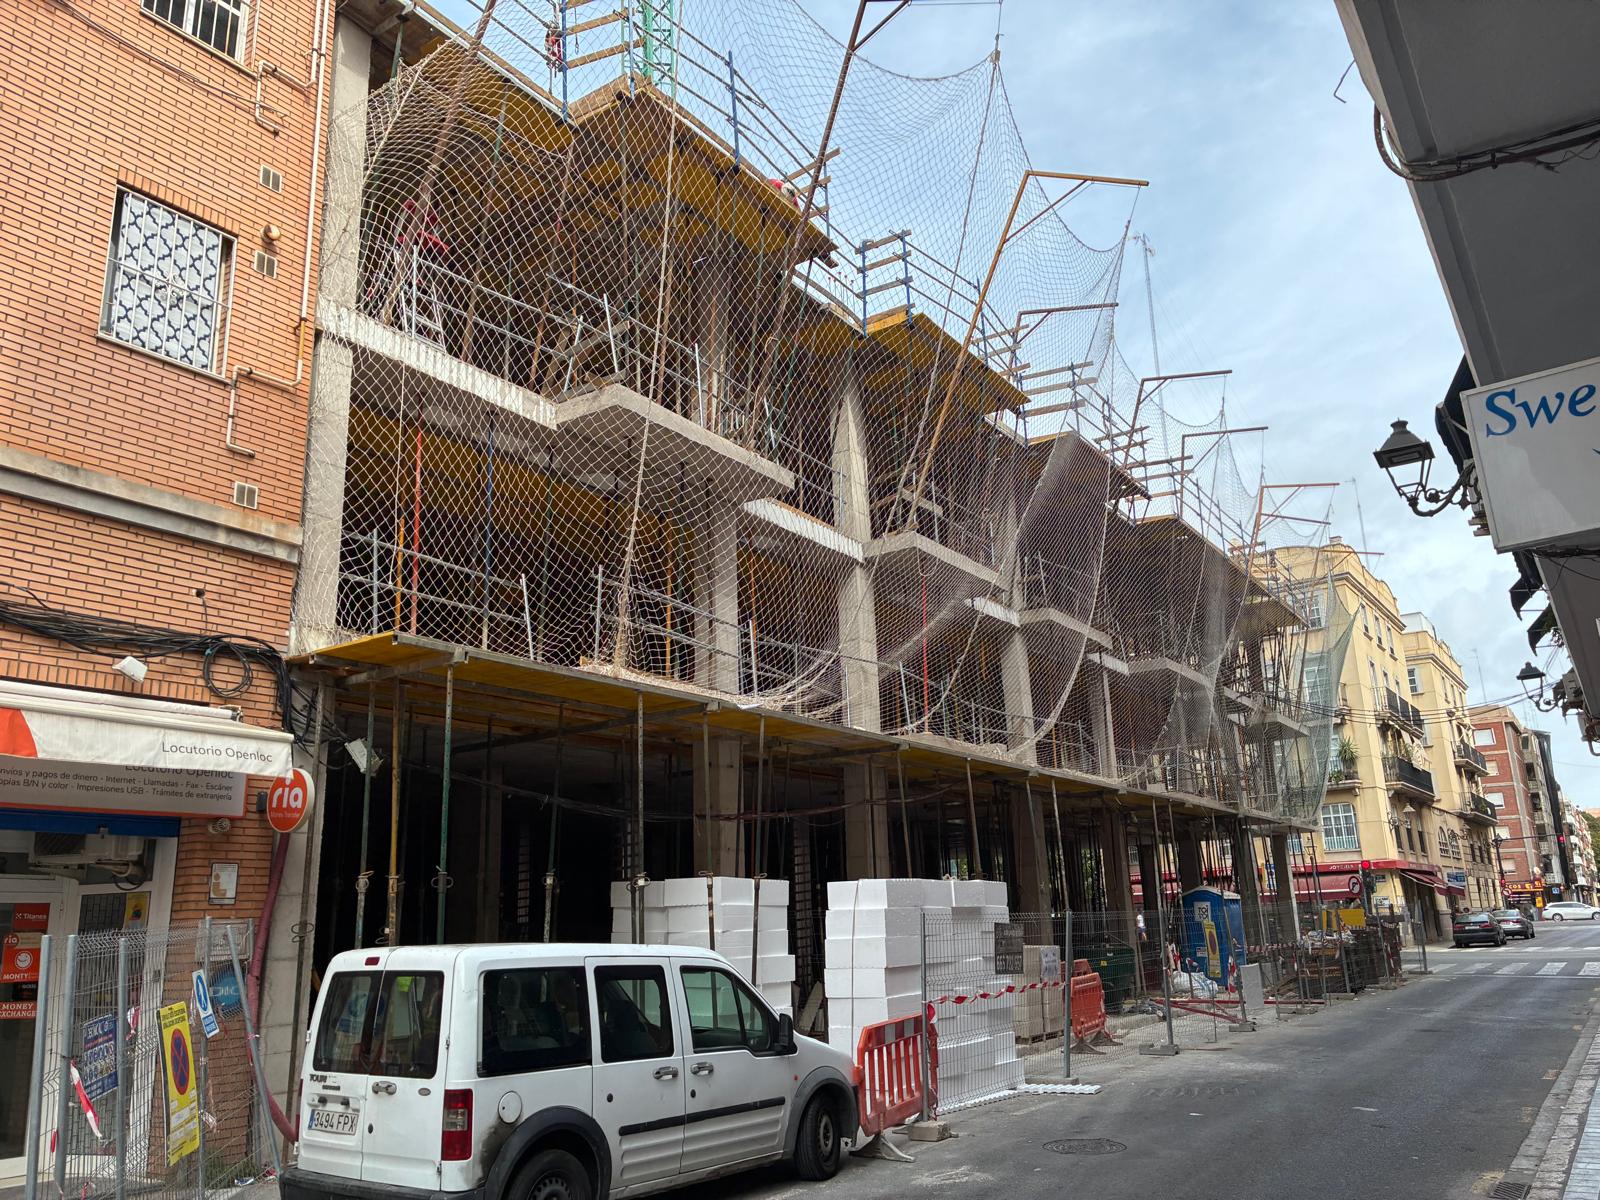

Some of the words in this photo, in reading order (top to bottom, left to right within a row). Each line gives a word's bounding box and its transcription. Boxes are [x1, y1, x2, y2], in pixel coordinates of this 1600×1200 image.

[1485, 384, 1597, 437] Swe
[162, 741, 222, 756] Locutorio
[225, 747, 273, 763] Openloc
[23, 778, 39, 788] B/N
[41, 780, 48, 789] y
[48, 782, 69, 790] color
[76, 783, 125, 793] Impresiones
[126, 786, 144, 795] USB
[185, 790, 195, 798] de
[25, 769, 31, 777] y
[32, 770, 58, 780] pagos
[60, 772, 71, 780] de
[73, 773, 98, 782] dinero
[105, 775, 136, 784] Internet
[143, 778, 179, 788] Llamadas
[185, 781, 200, 789] Fax
[271, 777, 304, 809] ria
[4, 935, 18, 944] ria
[314, 1111, 336, 1129] 3494
[336, 1113, 357, 1133] FPX
